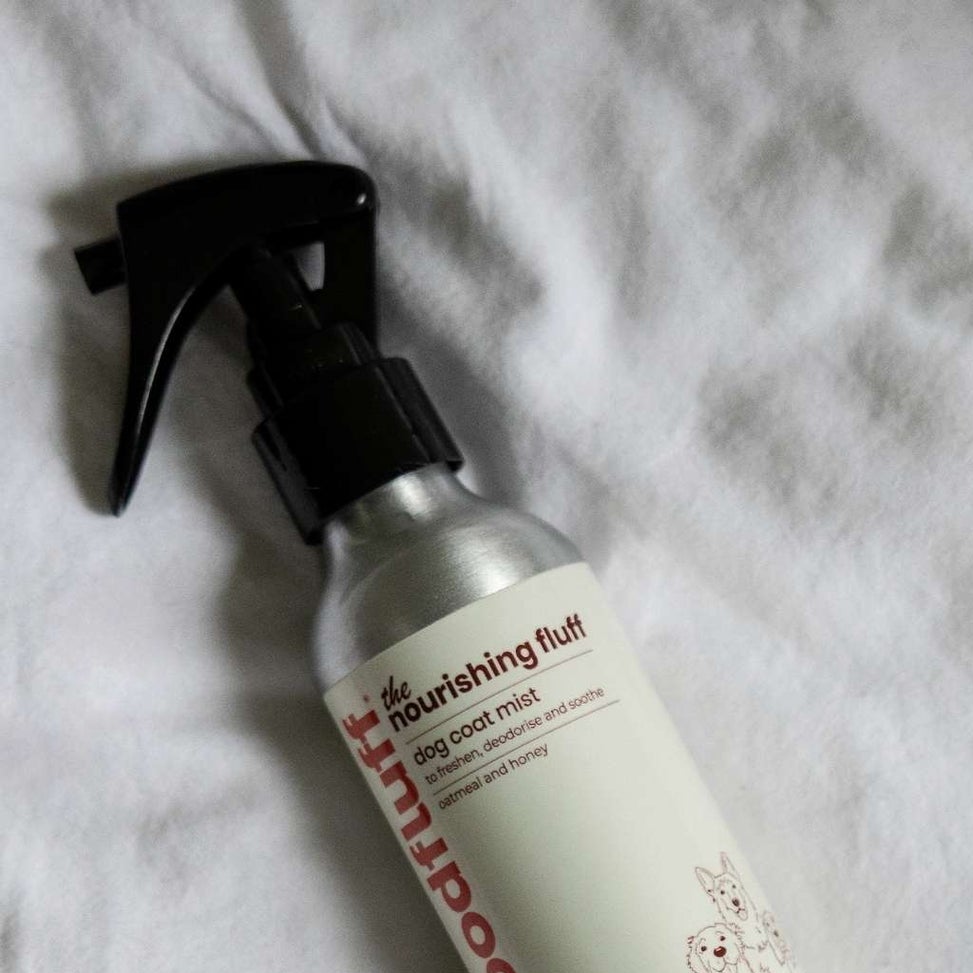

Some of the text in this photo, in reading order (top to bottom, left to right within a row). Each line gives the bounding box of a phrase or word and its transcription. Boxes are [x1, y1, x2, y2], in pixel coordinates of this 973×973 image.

[381, 675, 412, 711] the
[388, 613, 588, 733] nourishing fluff
[414, 687, 541, 766] dog coat mist
[425, 687, 605, 785] to freshen, deodorise and soothe
[438, 743, 548, 810] oatmeal and honey
